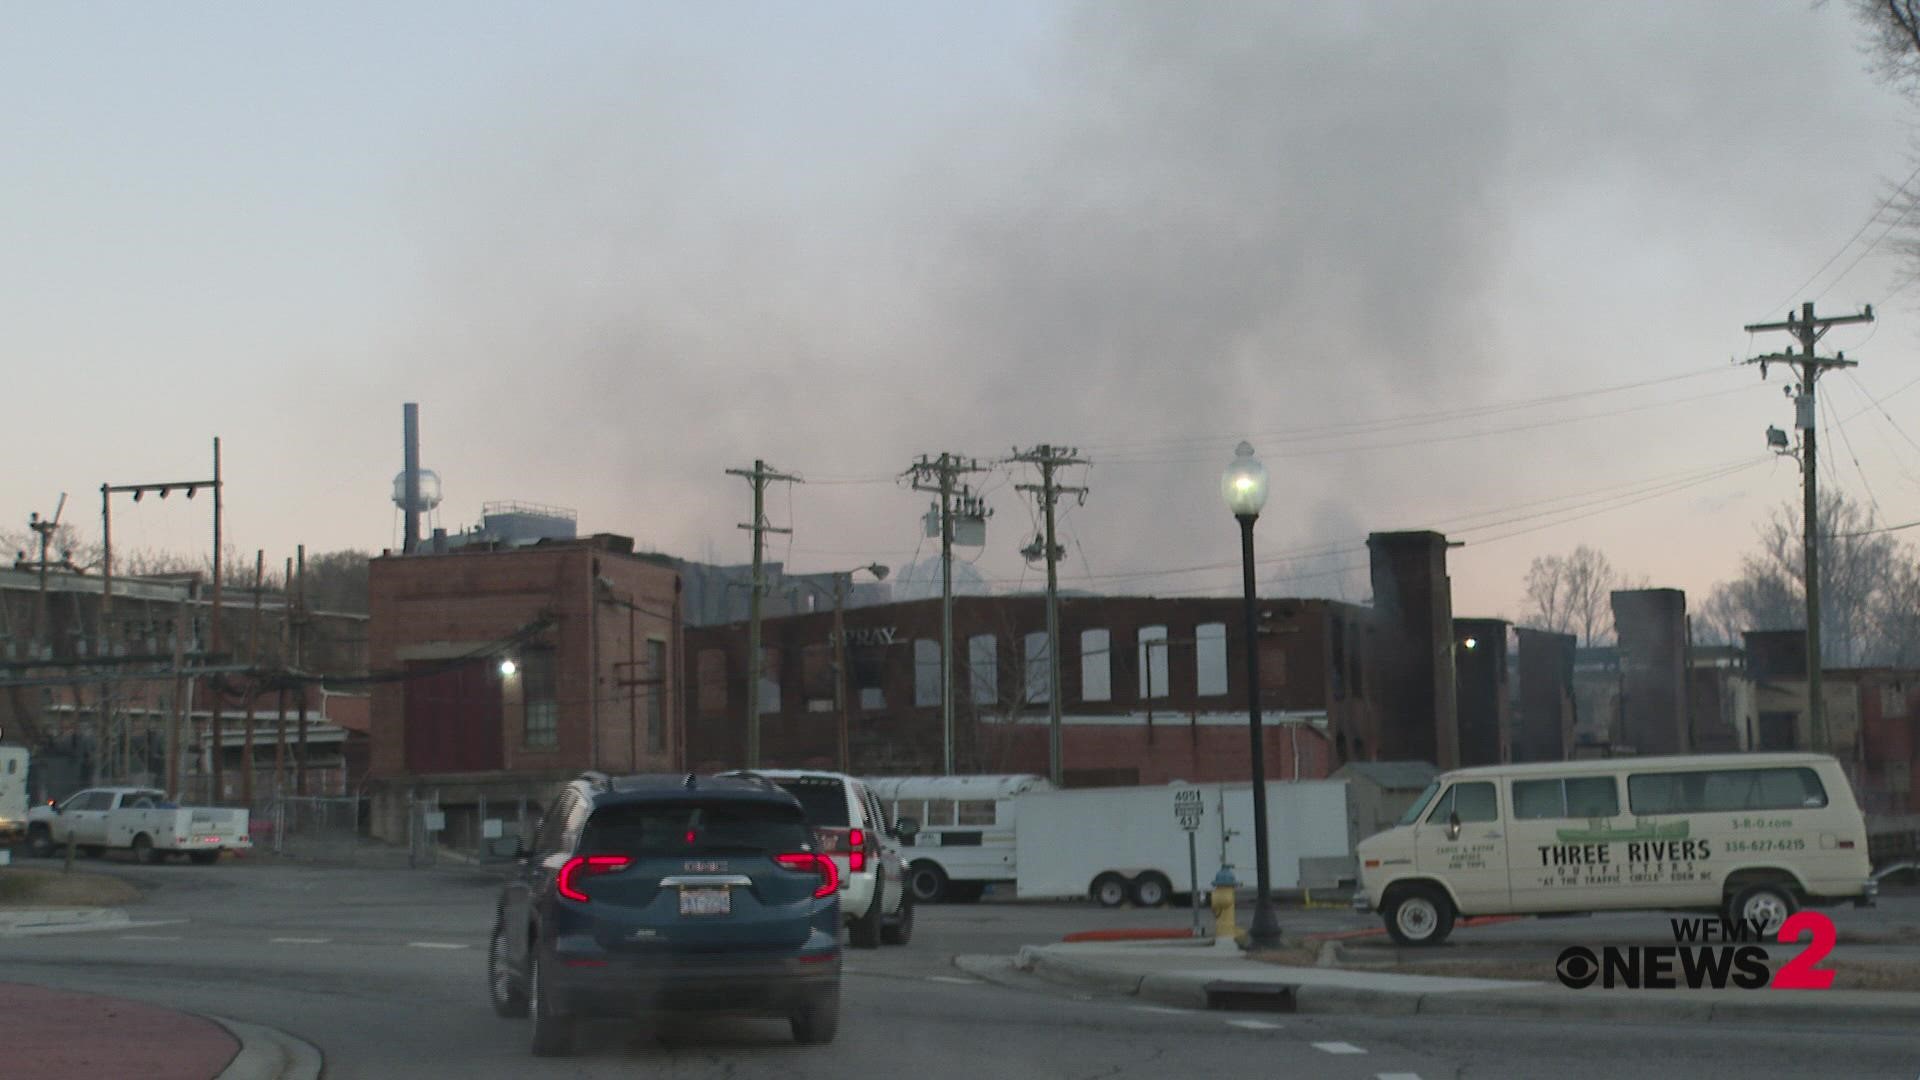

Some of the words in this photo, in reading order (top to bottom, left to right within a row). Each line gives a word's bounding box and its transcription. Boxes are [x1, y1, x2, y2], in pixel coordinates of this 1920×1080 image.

[828, 626, 898, 647] SPRAY
[1538, 844, 1610, 866] THREE
[1628, 839, 1711, 862] RIVERS
[1557, 862, 1693, 876] OUTFITTERS
[1561, 876, 1577, 885] THE
